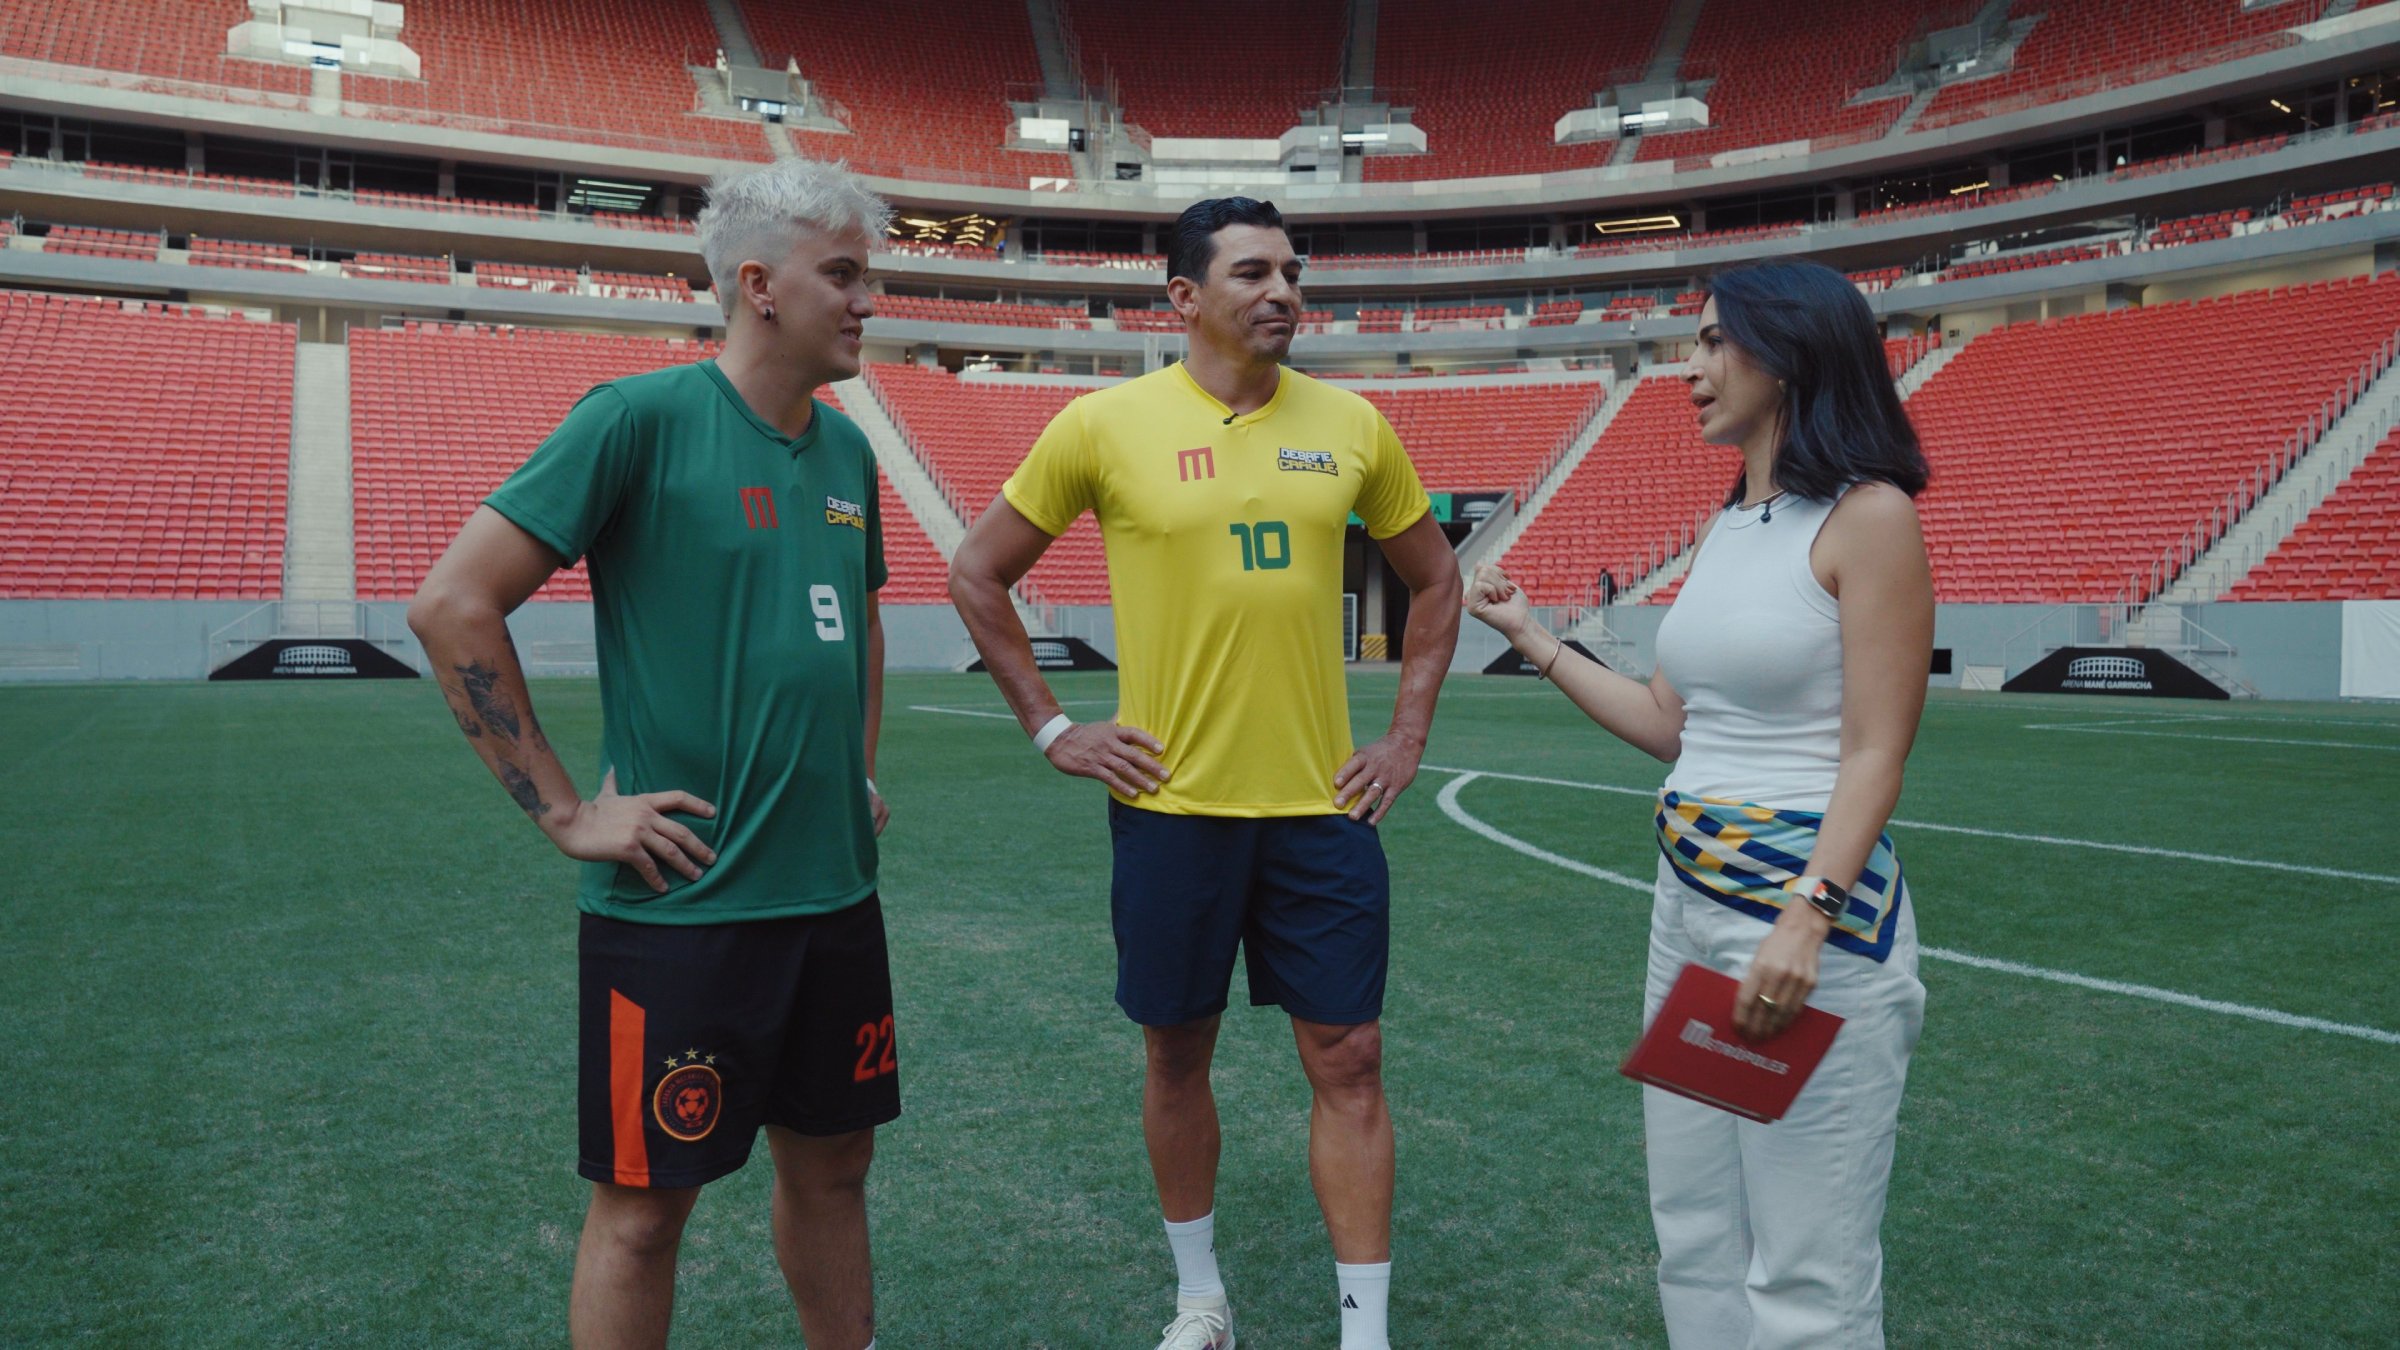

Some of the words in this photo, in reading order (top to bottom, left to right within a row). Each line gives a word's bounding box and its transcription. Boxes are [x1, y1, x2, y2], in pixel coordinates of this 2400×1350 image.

[1230, 521, 1291, 571] 10
[809, 584, 845, 641] 9
[2084, 679, 2106, 689] MANÉ
[2107, 680, 2152, 690] GARRINCHA
[854, 1014, 897, 1083] 22
